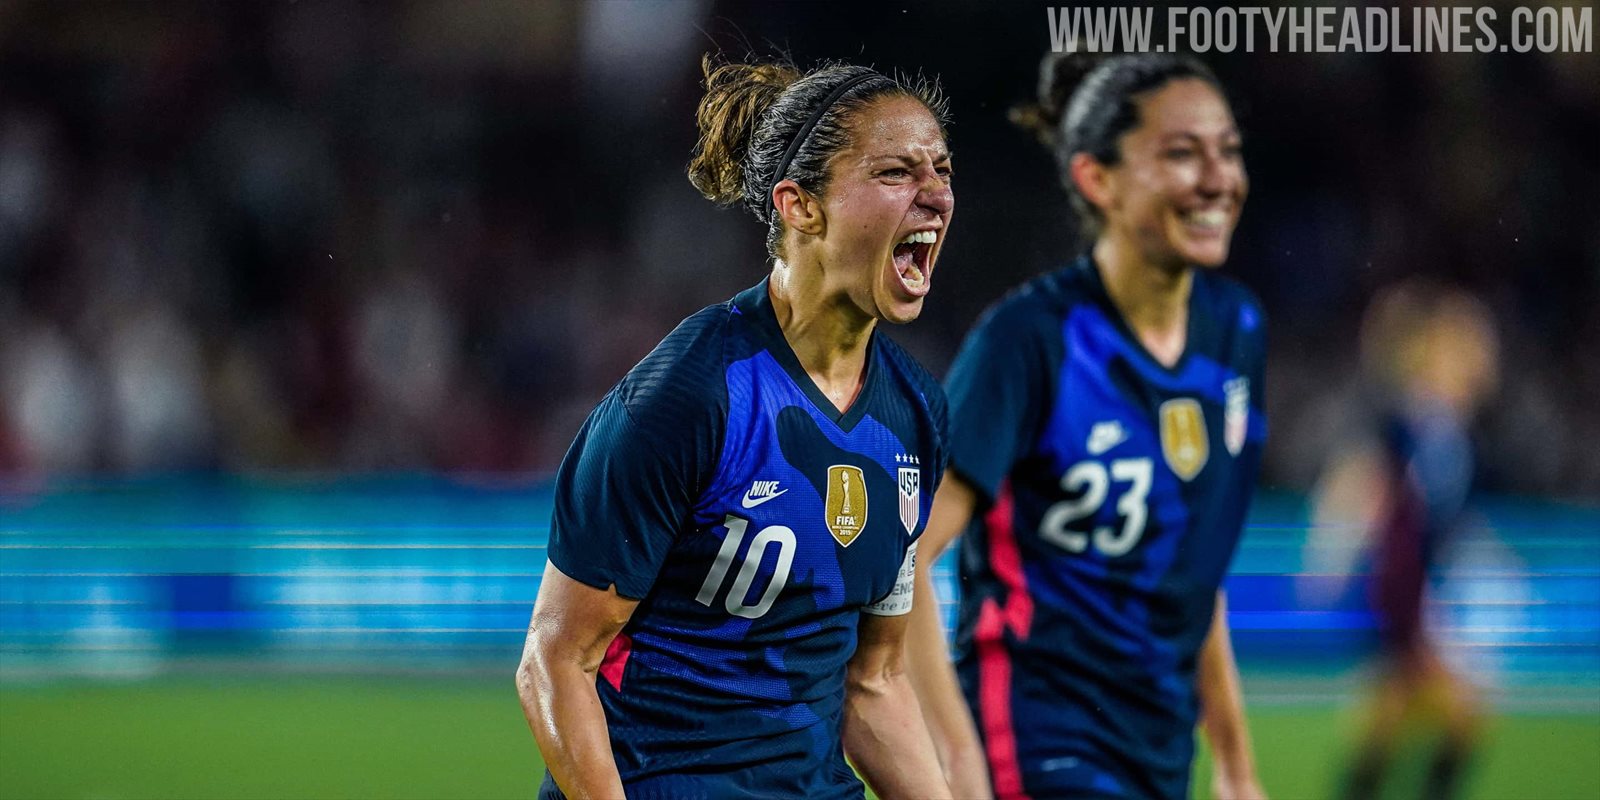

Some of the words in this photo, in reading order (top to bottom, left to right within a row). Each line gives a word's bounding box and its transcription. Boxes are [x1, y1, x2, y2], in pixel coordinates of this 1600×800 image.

[750, 481, 779, 497] NIKE
[900, 471, 918, 496] USA
[1039, 458, 1154, 557] 23
[836, 516, 855, 525] FIFA
[695, 514, 796, 619] 10
